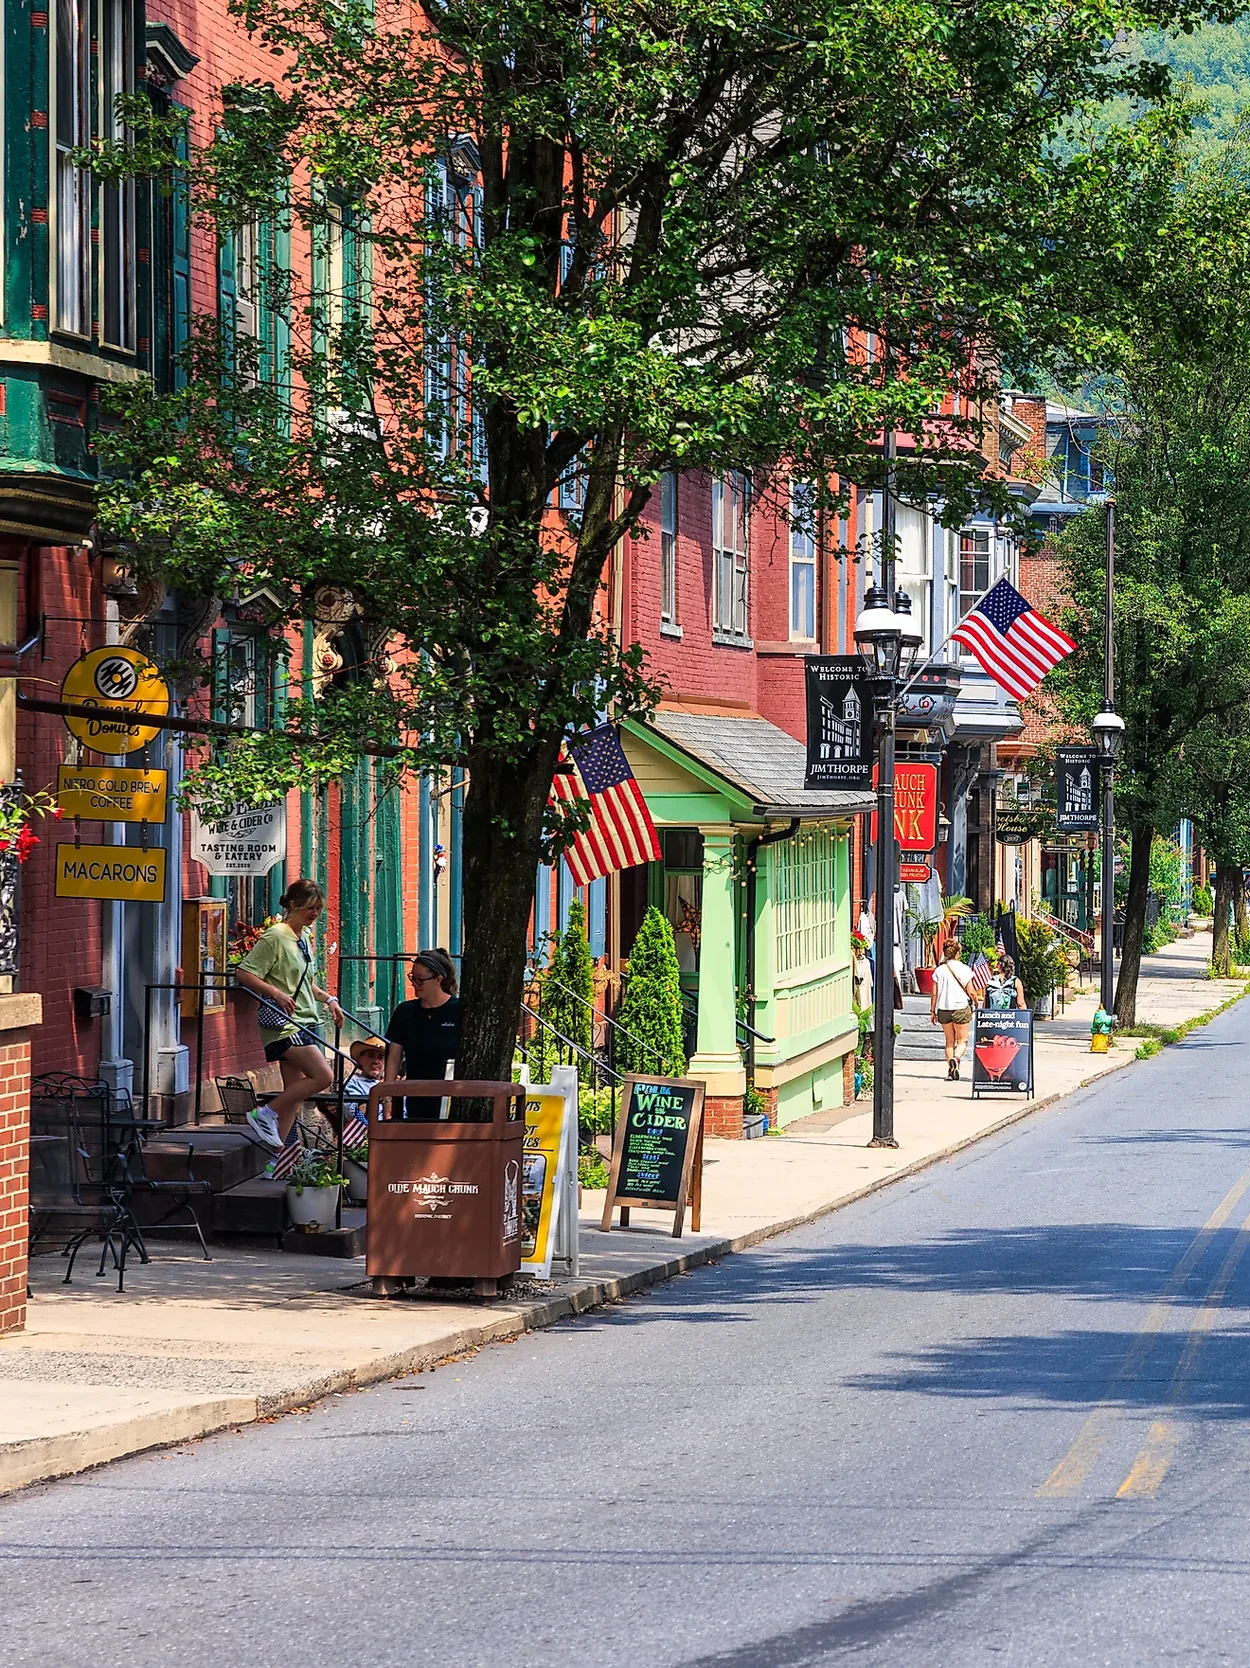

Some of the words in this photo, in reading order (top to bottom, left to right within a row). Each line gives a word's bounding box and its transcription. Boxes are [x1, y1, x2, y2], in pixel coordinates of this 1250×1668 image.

[809, 764, 827, 775] JIM
[827, 764, 869, 774] THORPE
[63, 778, 95, 790] NITRO
[98, 780, 128, 793] COLD
[130, 782, 162, 794] BREW
[893, 774, 925, 790] AUCH
[90, 796, 133, 810] COFFEE
[893, 792, 925, 808] UNK
[208, 820, 230, 835] WIE
[231, 821, 238, 831] &
[239, 815, 262, 829] CIDER
[893, 809, 925, 840] NK
[201, 844, 244, 852] TASTING
[247, 844, 276, 852] ROOM
[225, 853, 262, 861] EATERY
[63, 862, 157, 883] MACARONS
[977, 1011, 1000, 1019] Lunch
[1001, 1011, 1015, 1019] and
[977, 1020, 1014, 1030] Late-night
[1015, 1020, 1029, 1028] fun
[636, 1093, 684, 1112] WINE
[632, 1112, 687, 1131] CIDER
[388, 1184, 410, 1194] OLDE
[412, 1184, 446, 1195] MAUCH
[448, 1185, 479, 1195] CHUNK
